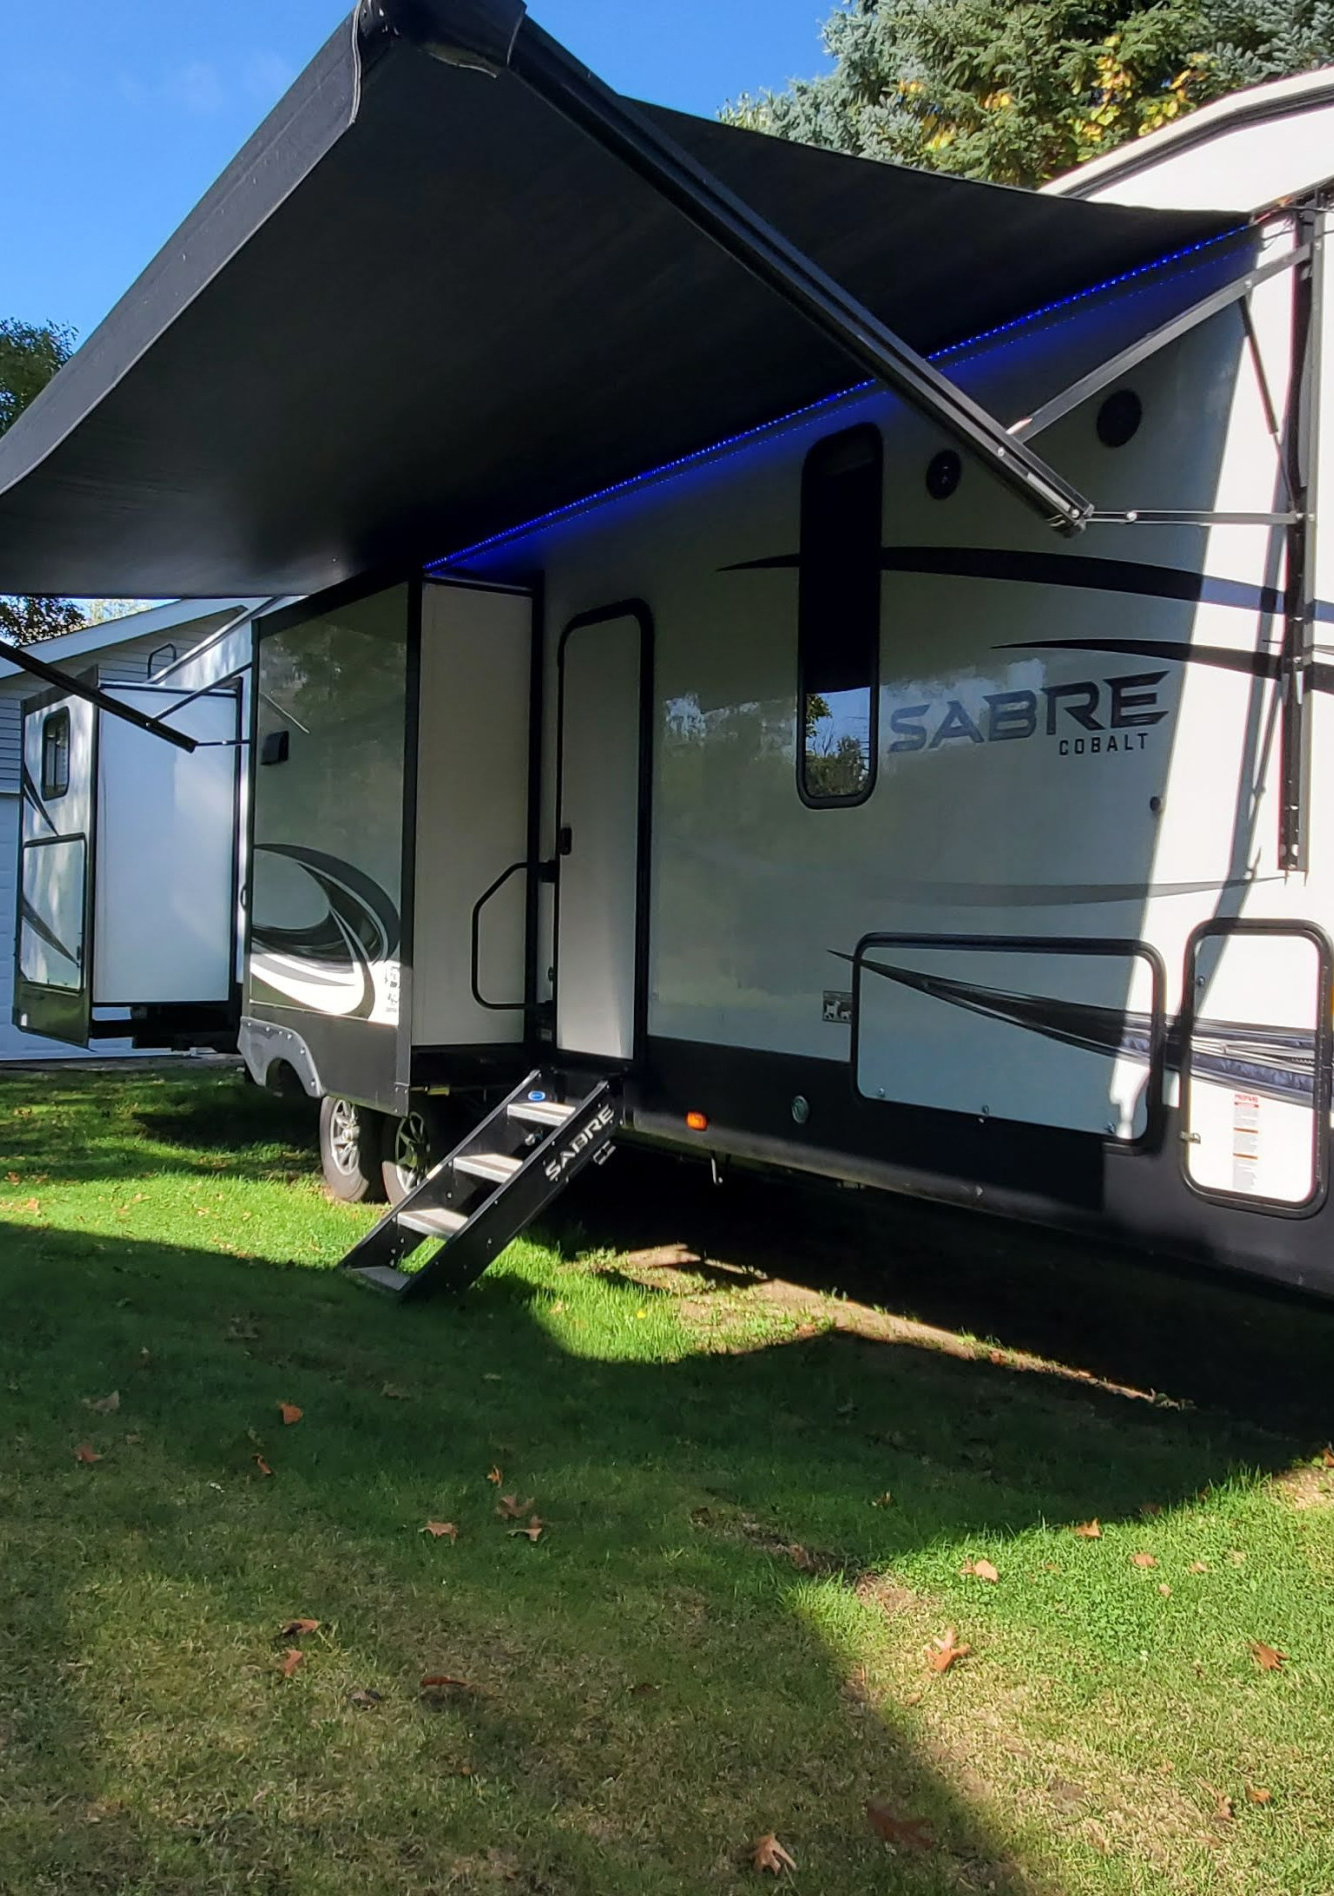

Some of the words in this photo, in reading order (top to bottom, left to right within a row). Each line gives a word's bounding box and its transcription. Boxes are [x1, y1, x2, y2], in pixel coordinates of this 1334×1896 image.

[888, 671, 1170, 755] SABRE
[1059, 733, 1149, 756] COBALT
[546, 1104, 614, 1181] SABRE
